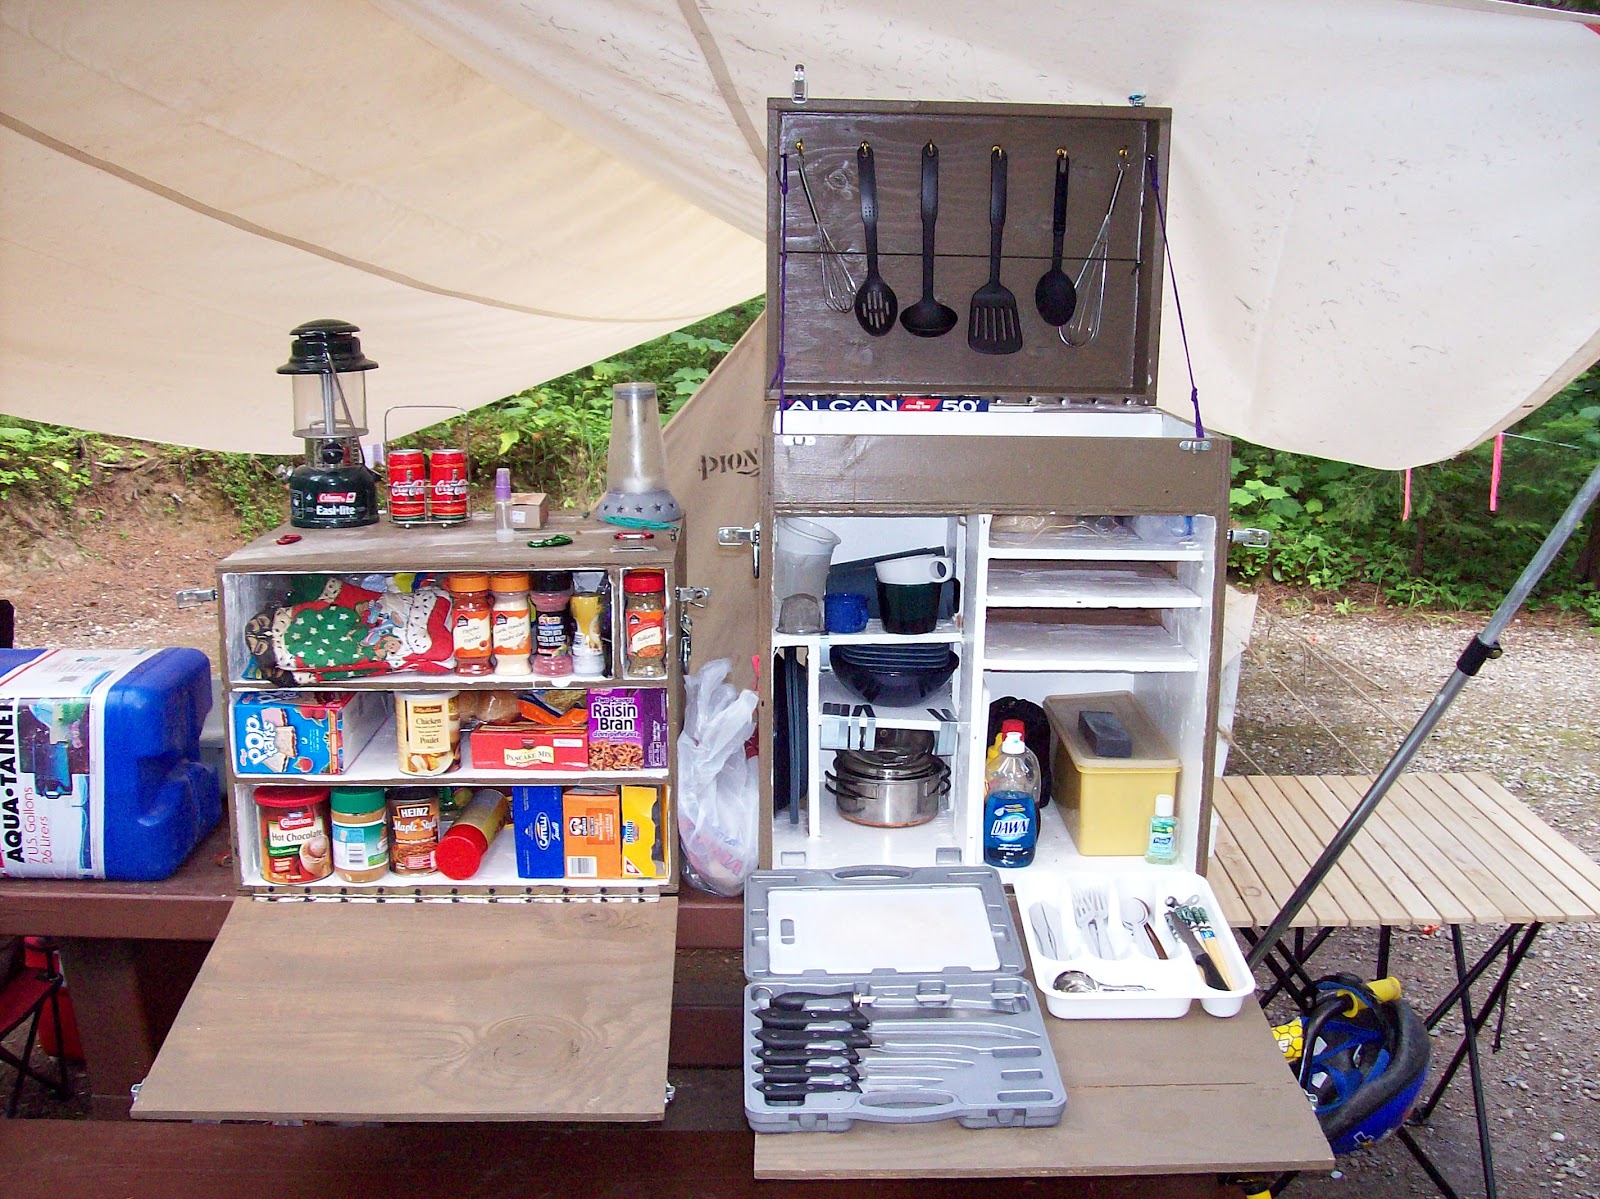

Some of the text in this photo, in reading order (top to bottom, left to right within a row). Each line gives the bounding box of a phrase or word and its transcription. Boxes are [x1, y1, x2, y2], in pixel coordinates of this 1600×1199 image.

[788, 399, 897, 412] ALCAN
[593, 703, 636, 717] Raisin
[416, 717, 442, 725] Chicken
[600, 718, 633, 731] Bran
[24, 786, 37, 833] Gallons
[401, 807, 429, 818] HEINZ
[992, 819, 1029, 835] DAWN
[271, 829, 322, 842] Hot Chocolate
[43, 848, 53, 865] 26
